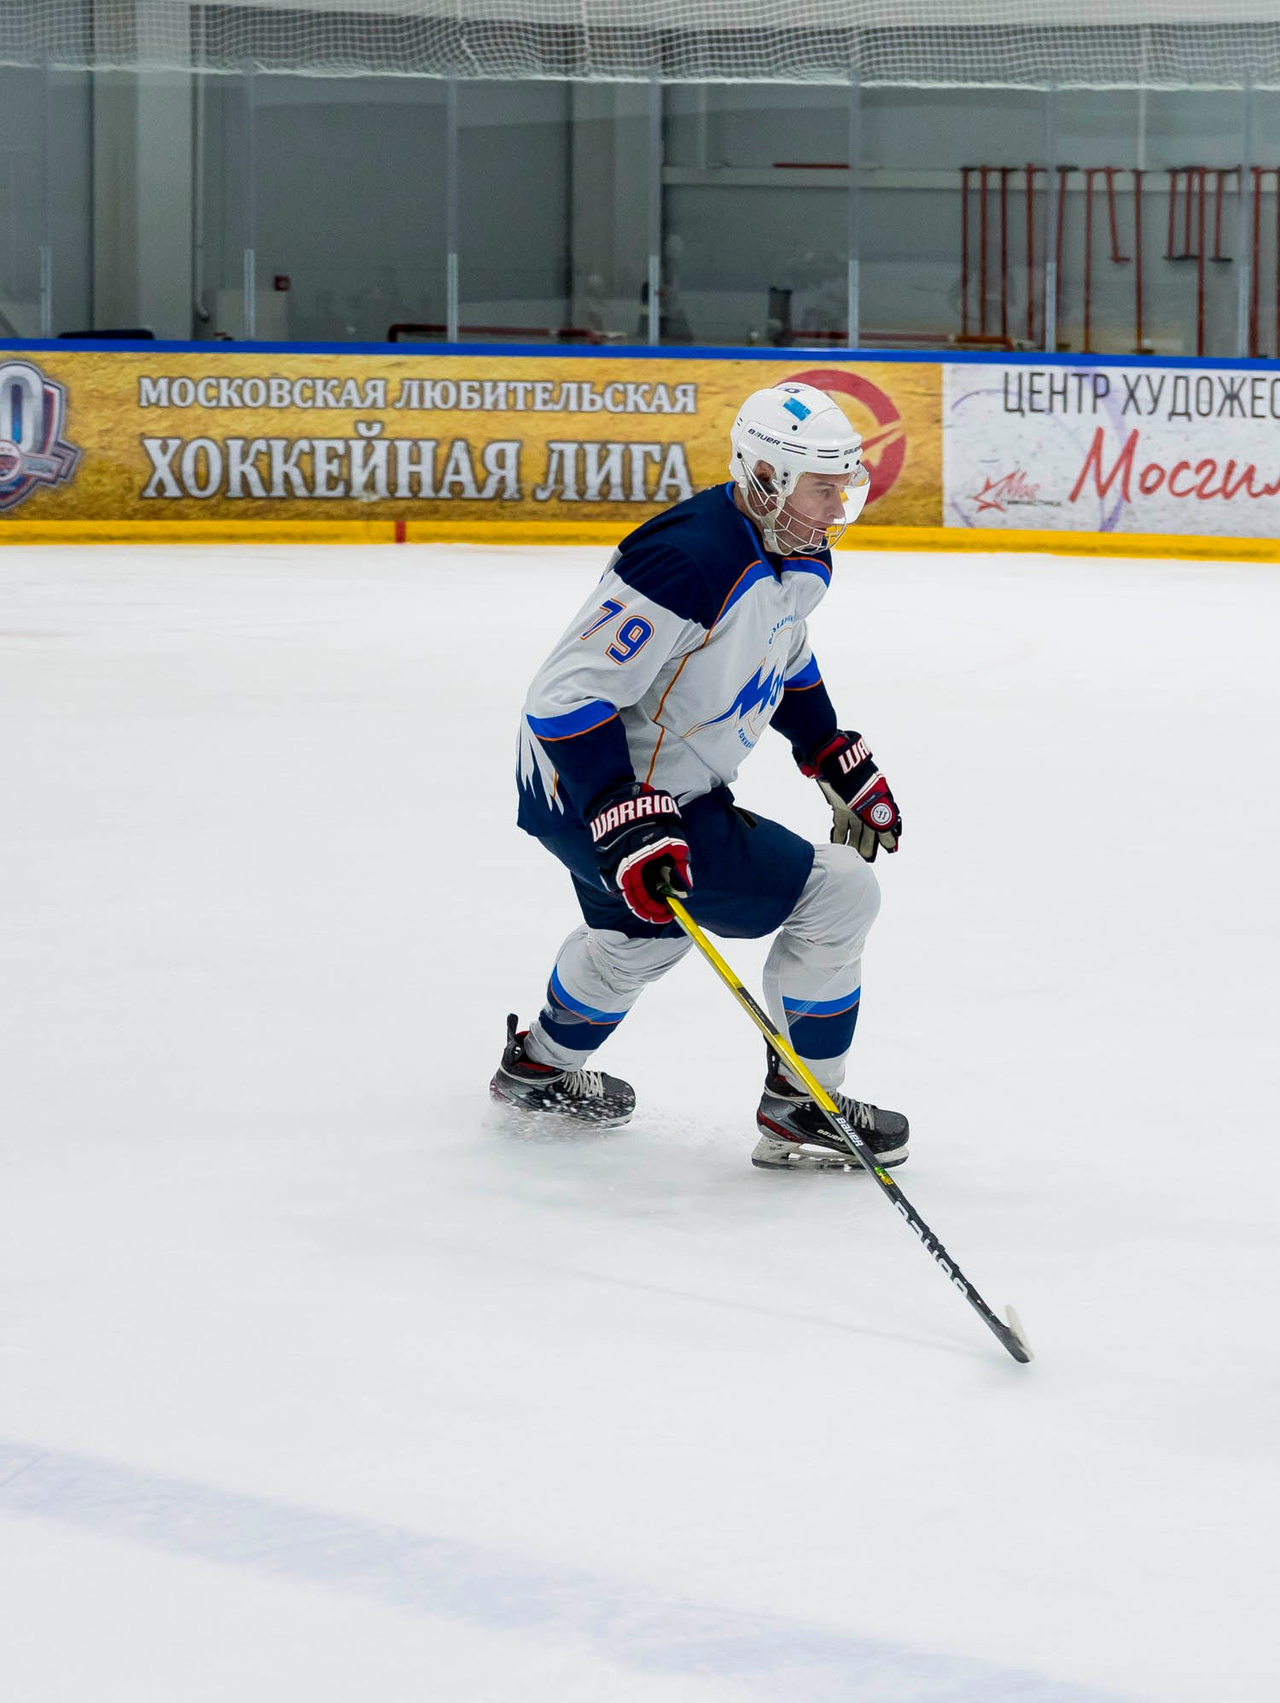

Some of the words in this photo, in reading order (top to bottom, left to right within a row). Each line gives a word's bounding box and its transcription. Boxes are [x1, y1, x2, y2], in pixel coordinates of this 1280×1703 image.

[138, 376, 387, 410] МОСКОВСКАЯ
[394, 379, 698, 414] ЛЮБИТЕЛЬСКАЯ
[1003, 371, 1110, 418] ЦЕНТР
[747, 427, 782, 447] BAUER
[142, 421, 522, 500] ХОККЕЙНАЯ
[534, 440, 696, 501] ЛИГА
[579, 597, 656, 666] 79
[834, 1116, 865, 1148] BAUER
